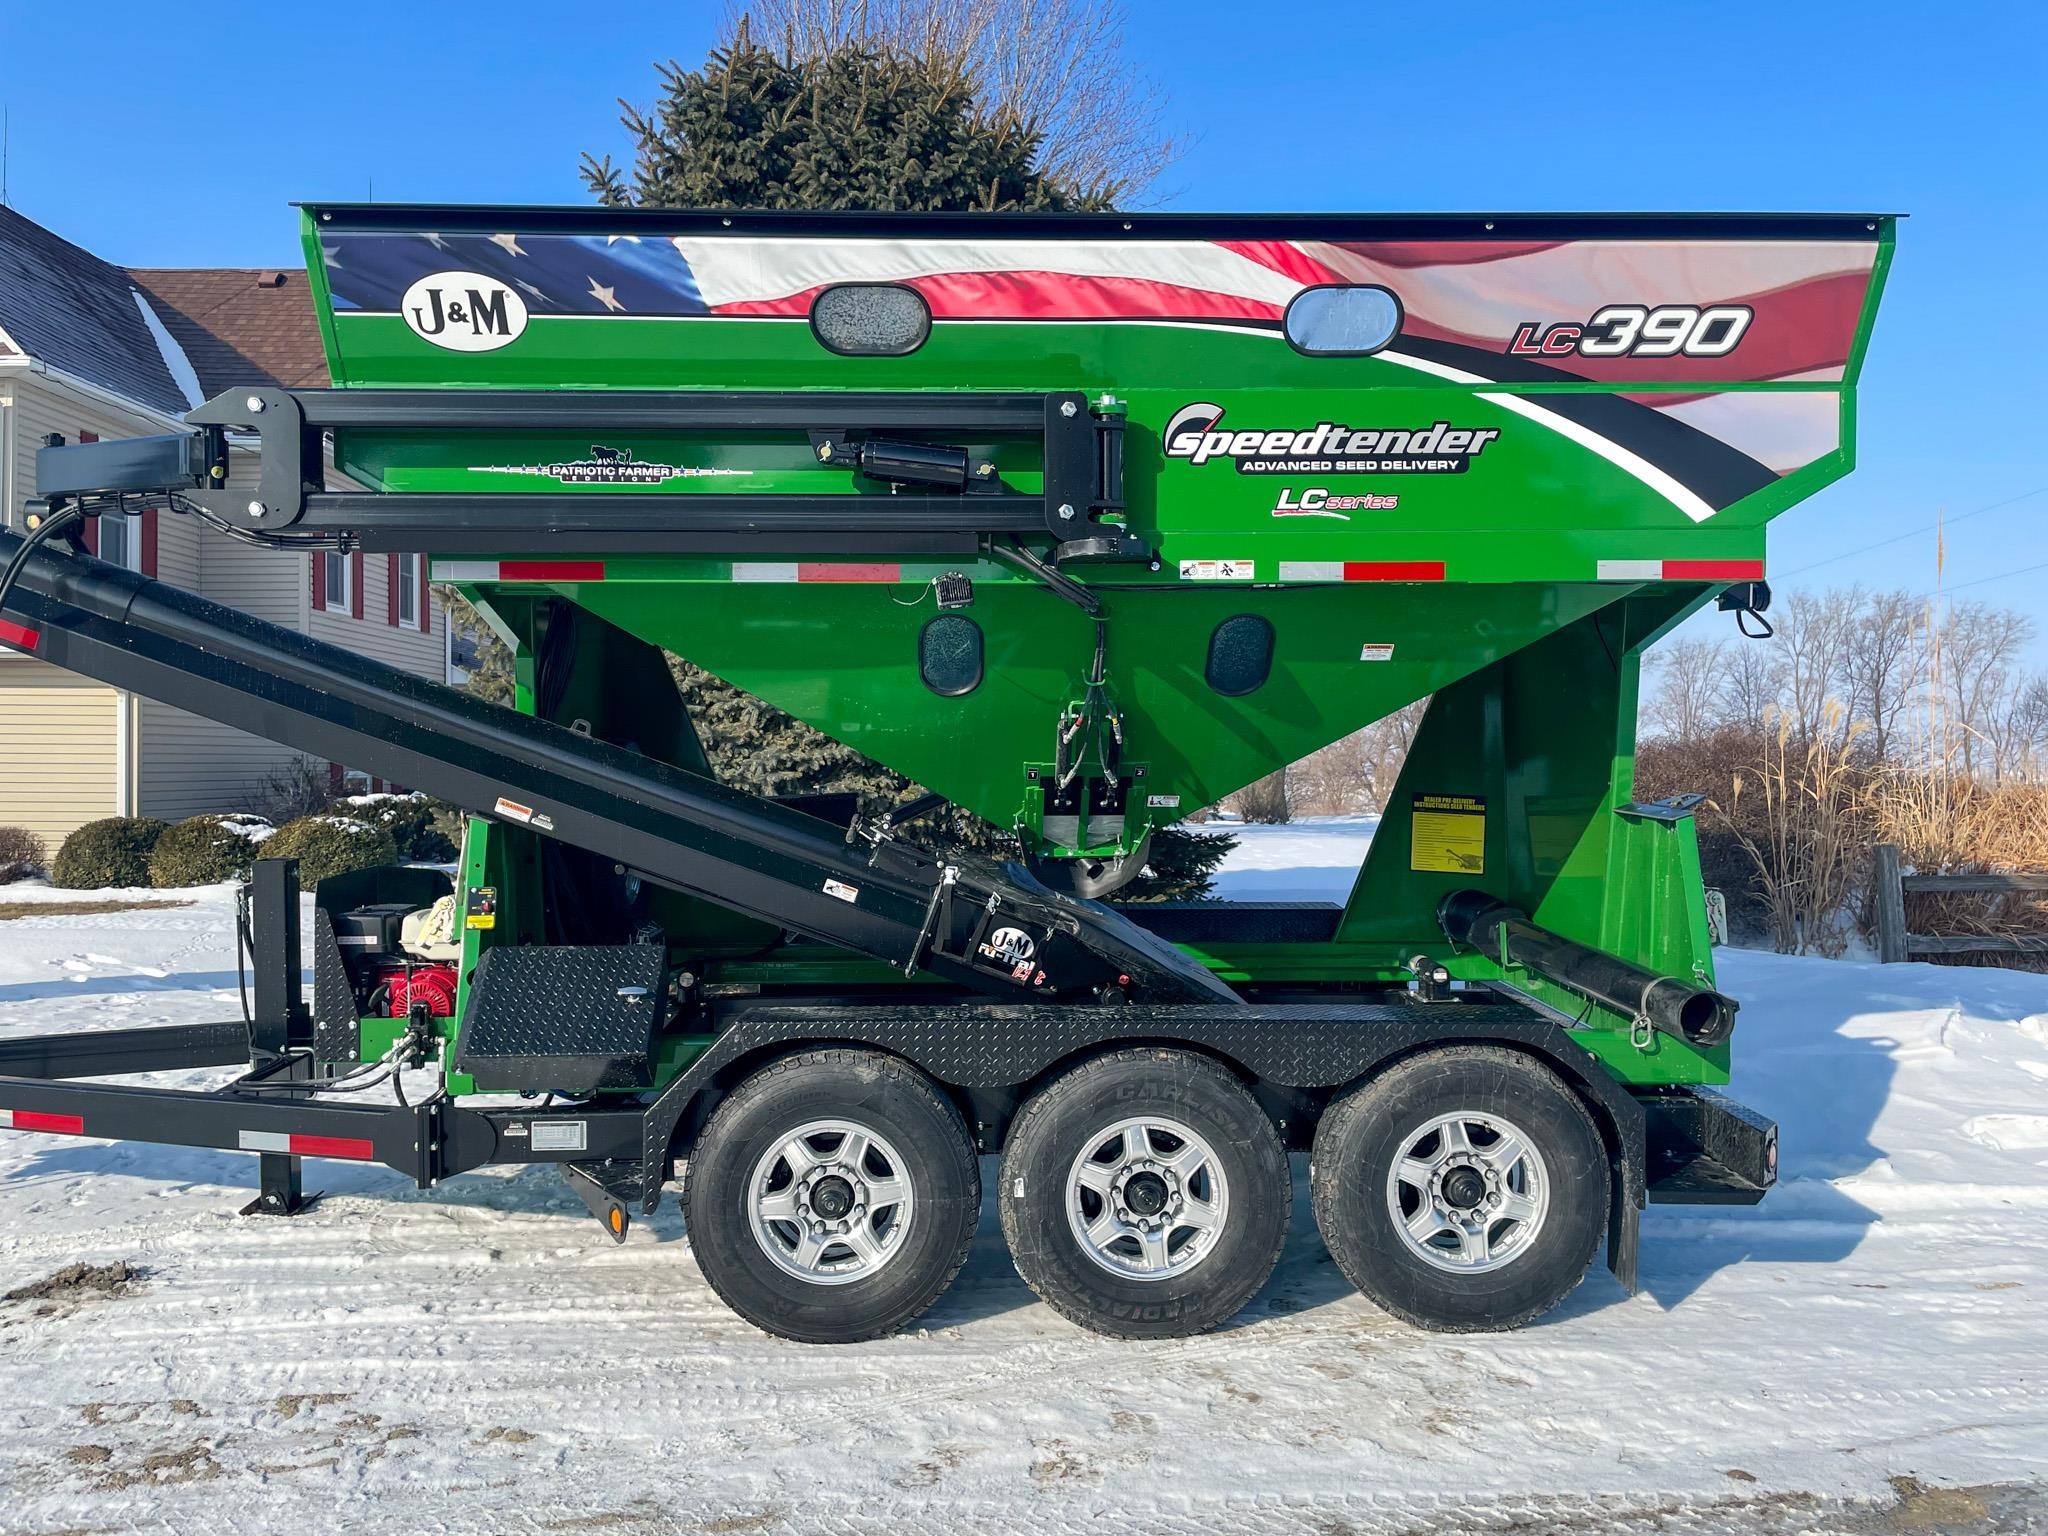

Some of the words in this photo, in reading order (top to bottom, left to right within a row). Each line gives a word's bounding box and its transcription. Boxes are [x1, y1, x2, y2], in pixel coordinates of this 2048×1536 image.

[411, 288, 512, 335] J&M
[1164, 402, 1499, 464] Speedtender
[552, 466, 616, 476] PATRIOTIC
[618, 466, 670, 477] FARMER
[1242, 460, 1332, 472] ADVANCED
[1335, 460, 1378, 471] SEED
[1381, 459, 1459, 471] DELIVERY
[994, 931, 1031, 956] J&M
